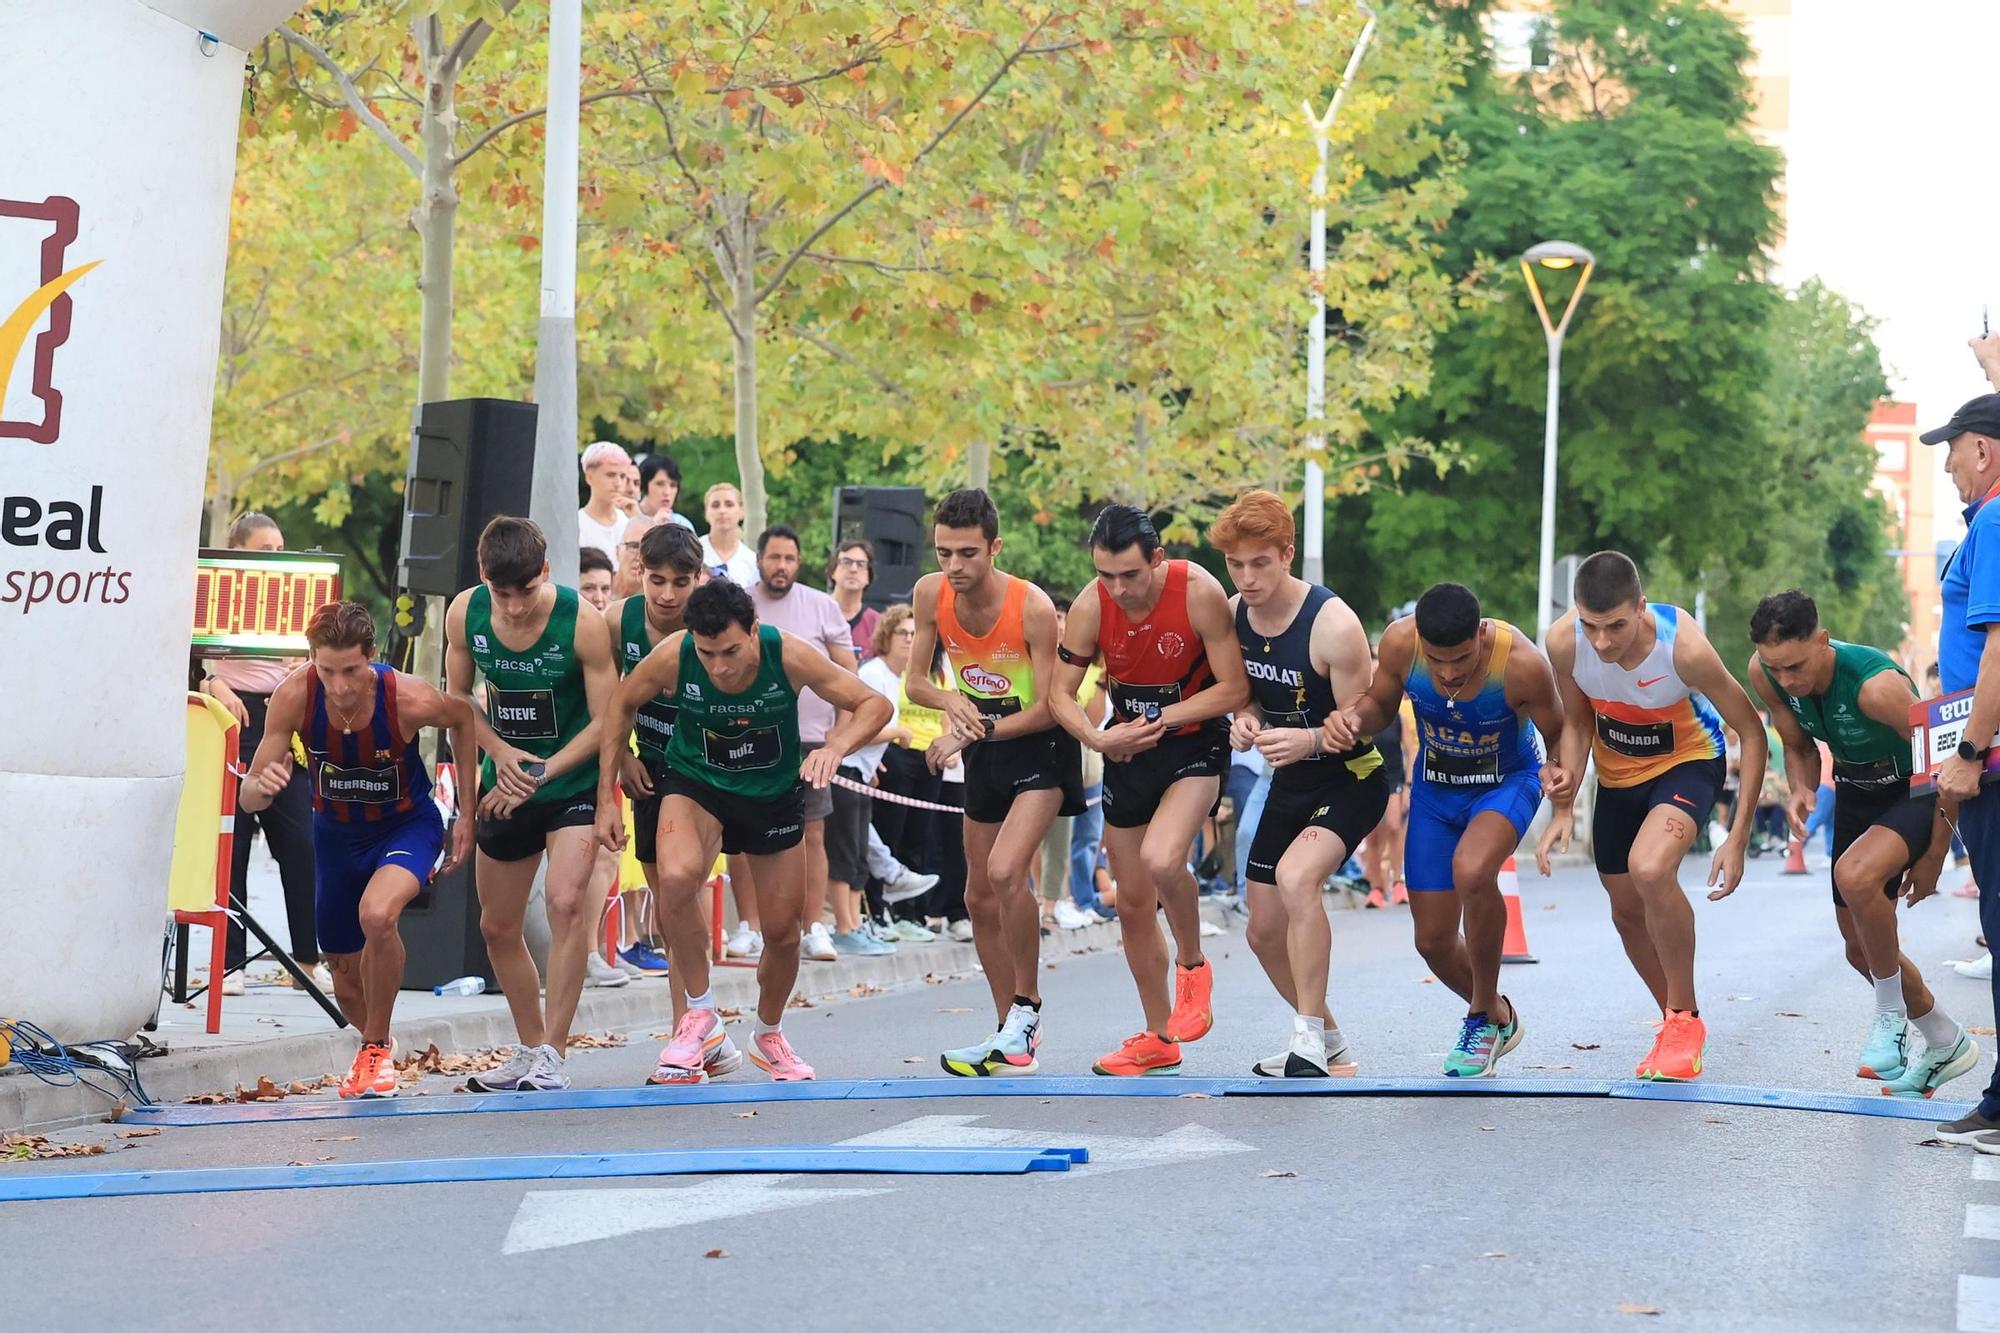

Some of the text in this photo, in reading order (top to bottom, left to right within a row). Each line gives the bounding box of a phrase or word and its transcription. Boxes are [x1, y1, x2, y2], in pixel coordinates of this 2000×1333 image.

[1, 565, 132, 615] sports
[495, 659, 534, 673] Facsa
[1243, 658, 1299, 687] EDOLAT
[497, 704, 538, 721] ESTEVE
[709, 704, 757, 714] Facsa
[1608, 728, 1661, 746] QUIJADA
[728, 742, 756, 760] RUÍZ
[329, 779, 390, 792] HERREROS
[1302, 830, 1318, 842] 49
[1664, 817, 1685, 840] 53
